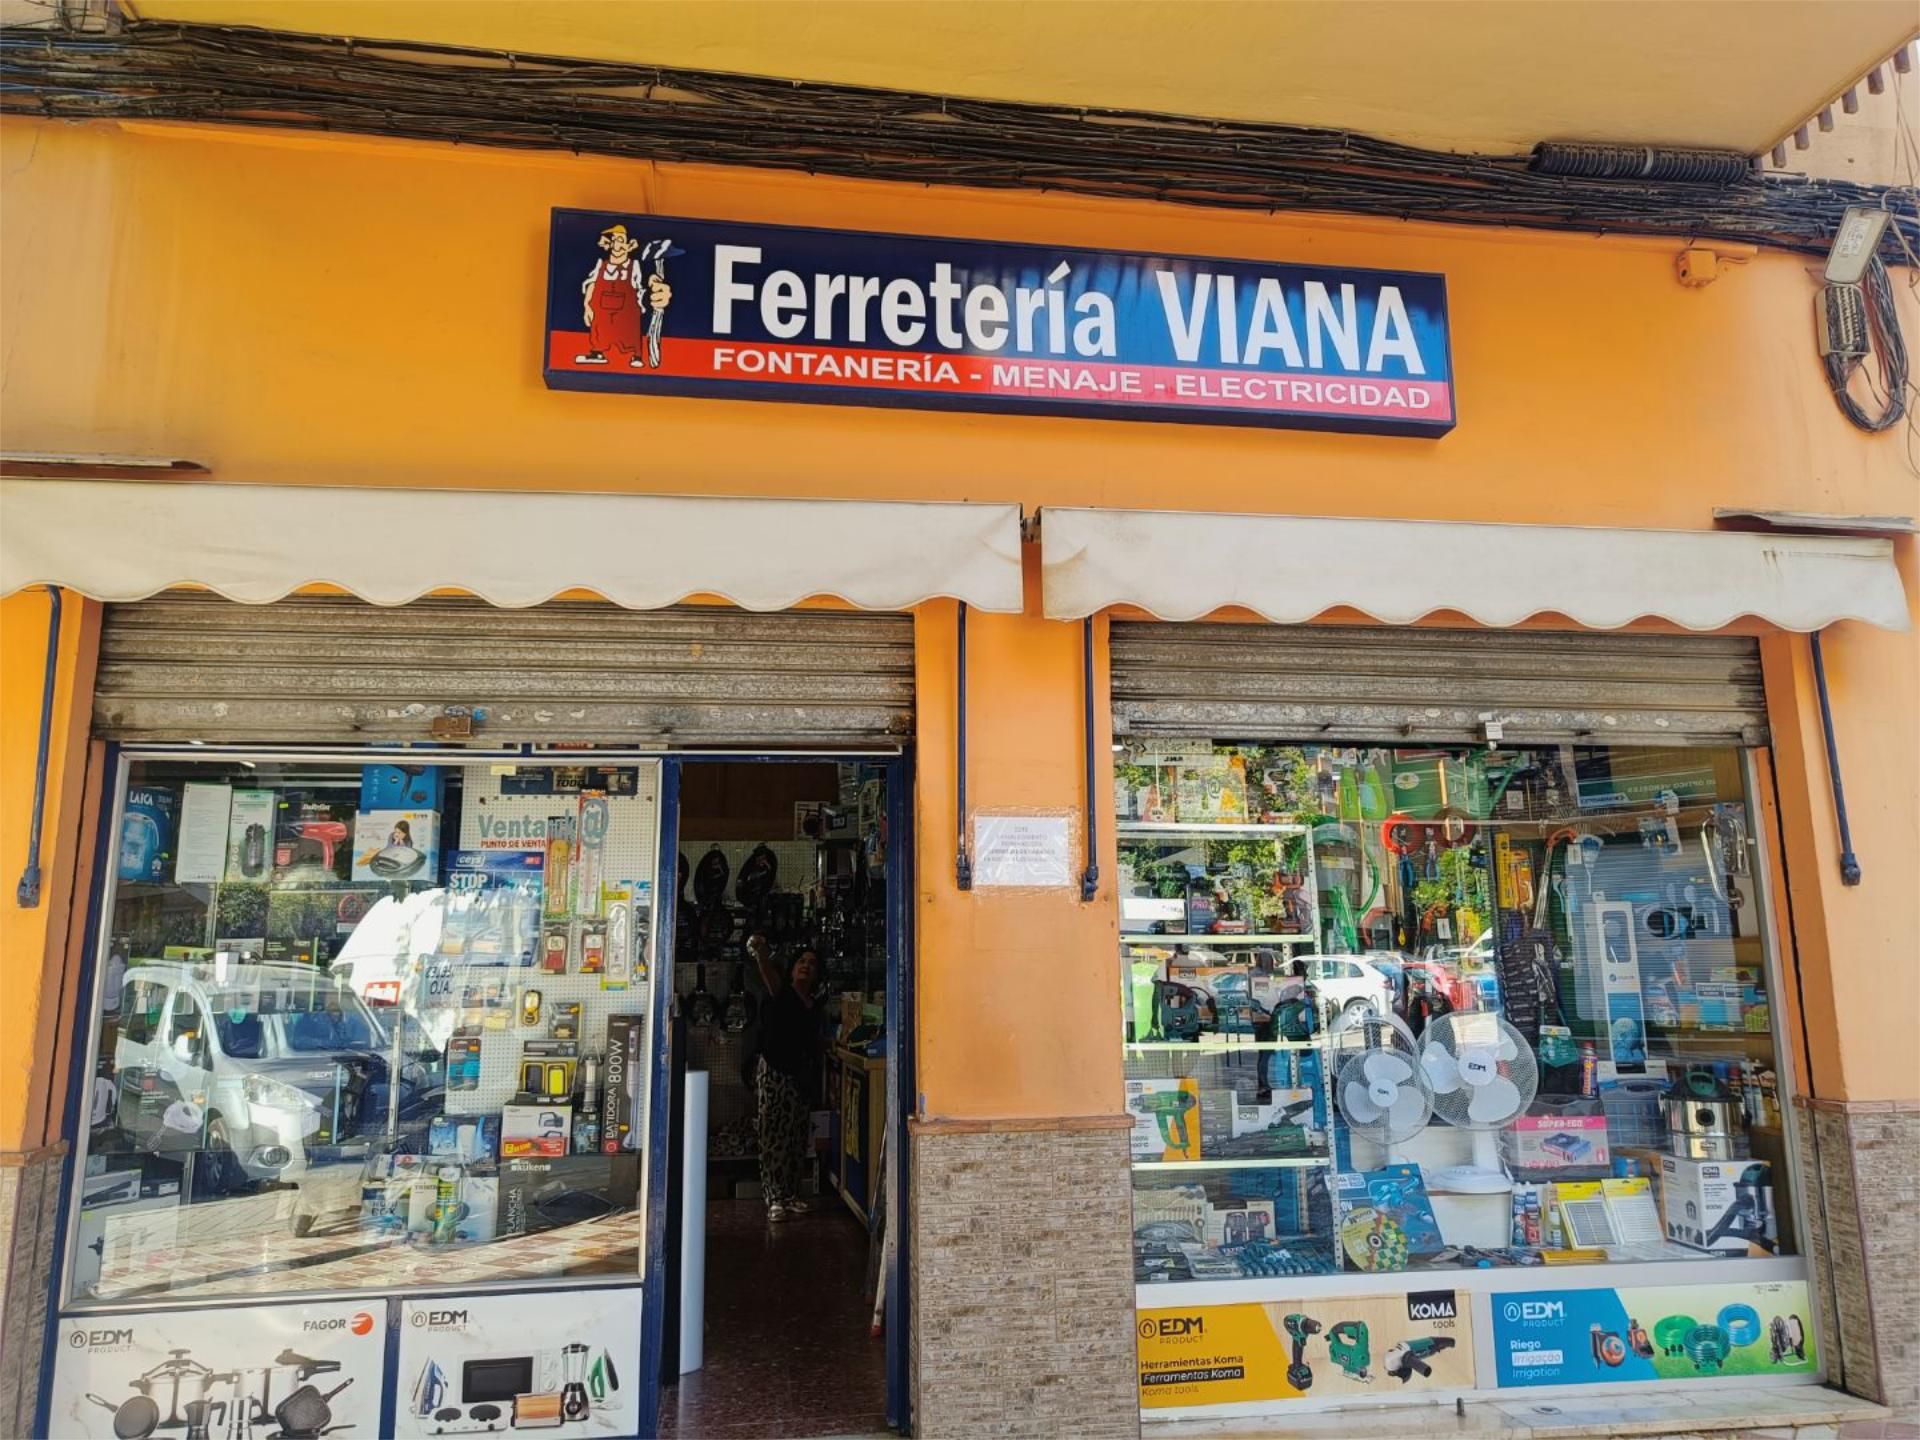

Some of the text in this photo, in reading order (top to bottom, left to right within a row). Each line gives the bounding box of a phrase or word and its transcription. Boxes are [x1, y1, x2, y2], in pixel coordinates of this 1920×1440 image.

[712, 244, 1427, 375] Ferretería VIANA
[713, 347, 960, 384] FONTANERÍA
[992, 364, 1141, 394] MENAJE
[1175, 374, 1431, 410] ELECTRICIDAD
[481, 840, 546, 848] PUNTO DE VENTA
[449, 873, 488, 889] STOP
[608, 1038, 624, 1084] 800W
[605, 1087, 617, 1138] BATIDORA
[1410, 1302, 1455, 1319] KOMA
[1522, 1301, 1564, 1319] EDM
[303, 1318, 347, 1332] FAGOR
[430, 1310, 469, 1326] EDM
[1433, 1319, 1455, 1329] tools
[1523, 1318, 1565, 1327] PRODUCT
[427, 1324, 469, 1332] PRODUCT
[1159, 1317, 1203, 1336] EDM
[89, 1328, 133, 1347] EDM
[1160, 1335, 1204, 1345] PRODUCT
[87, 1344, 132, 1354] PRODUCT
[1510, 1339, 1541, 1352] Riego
[1140, 1355, 1244, 1370] Herramientas Koma
[1143, 1368, 1242, 1384] Ferramentas Koma
[1512, 1366, 1560, 1379] Irrigation
[1141, 1384, 1200, 1397] Koma tools
